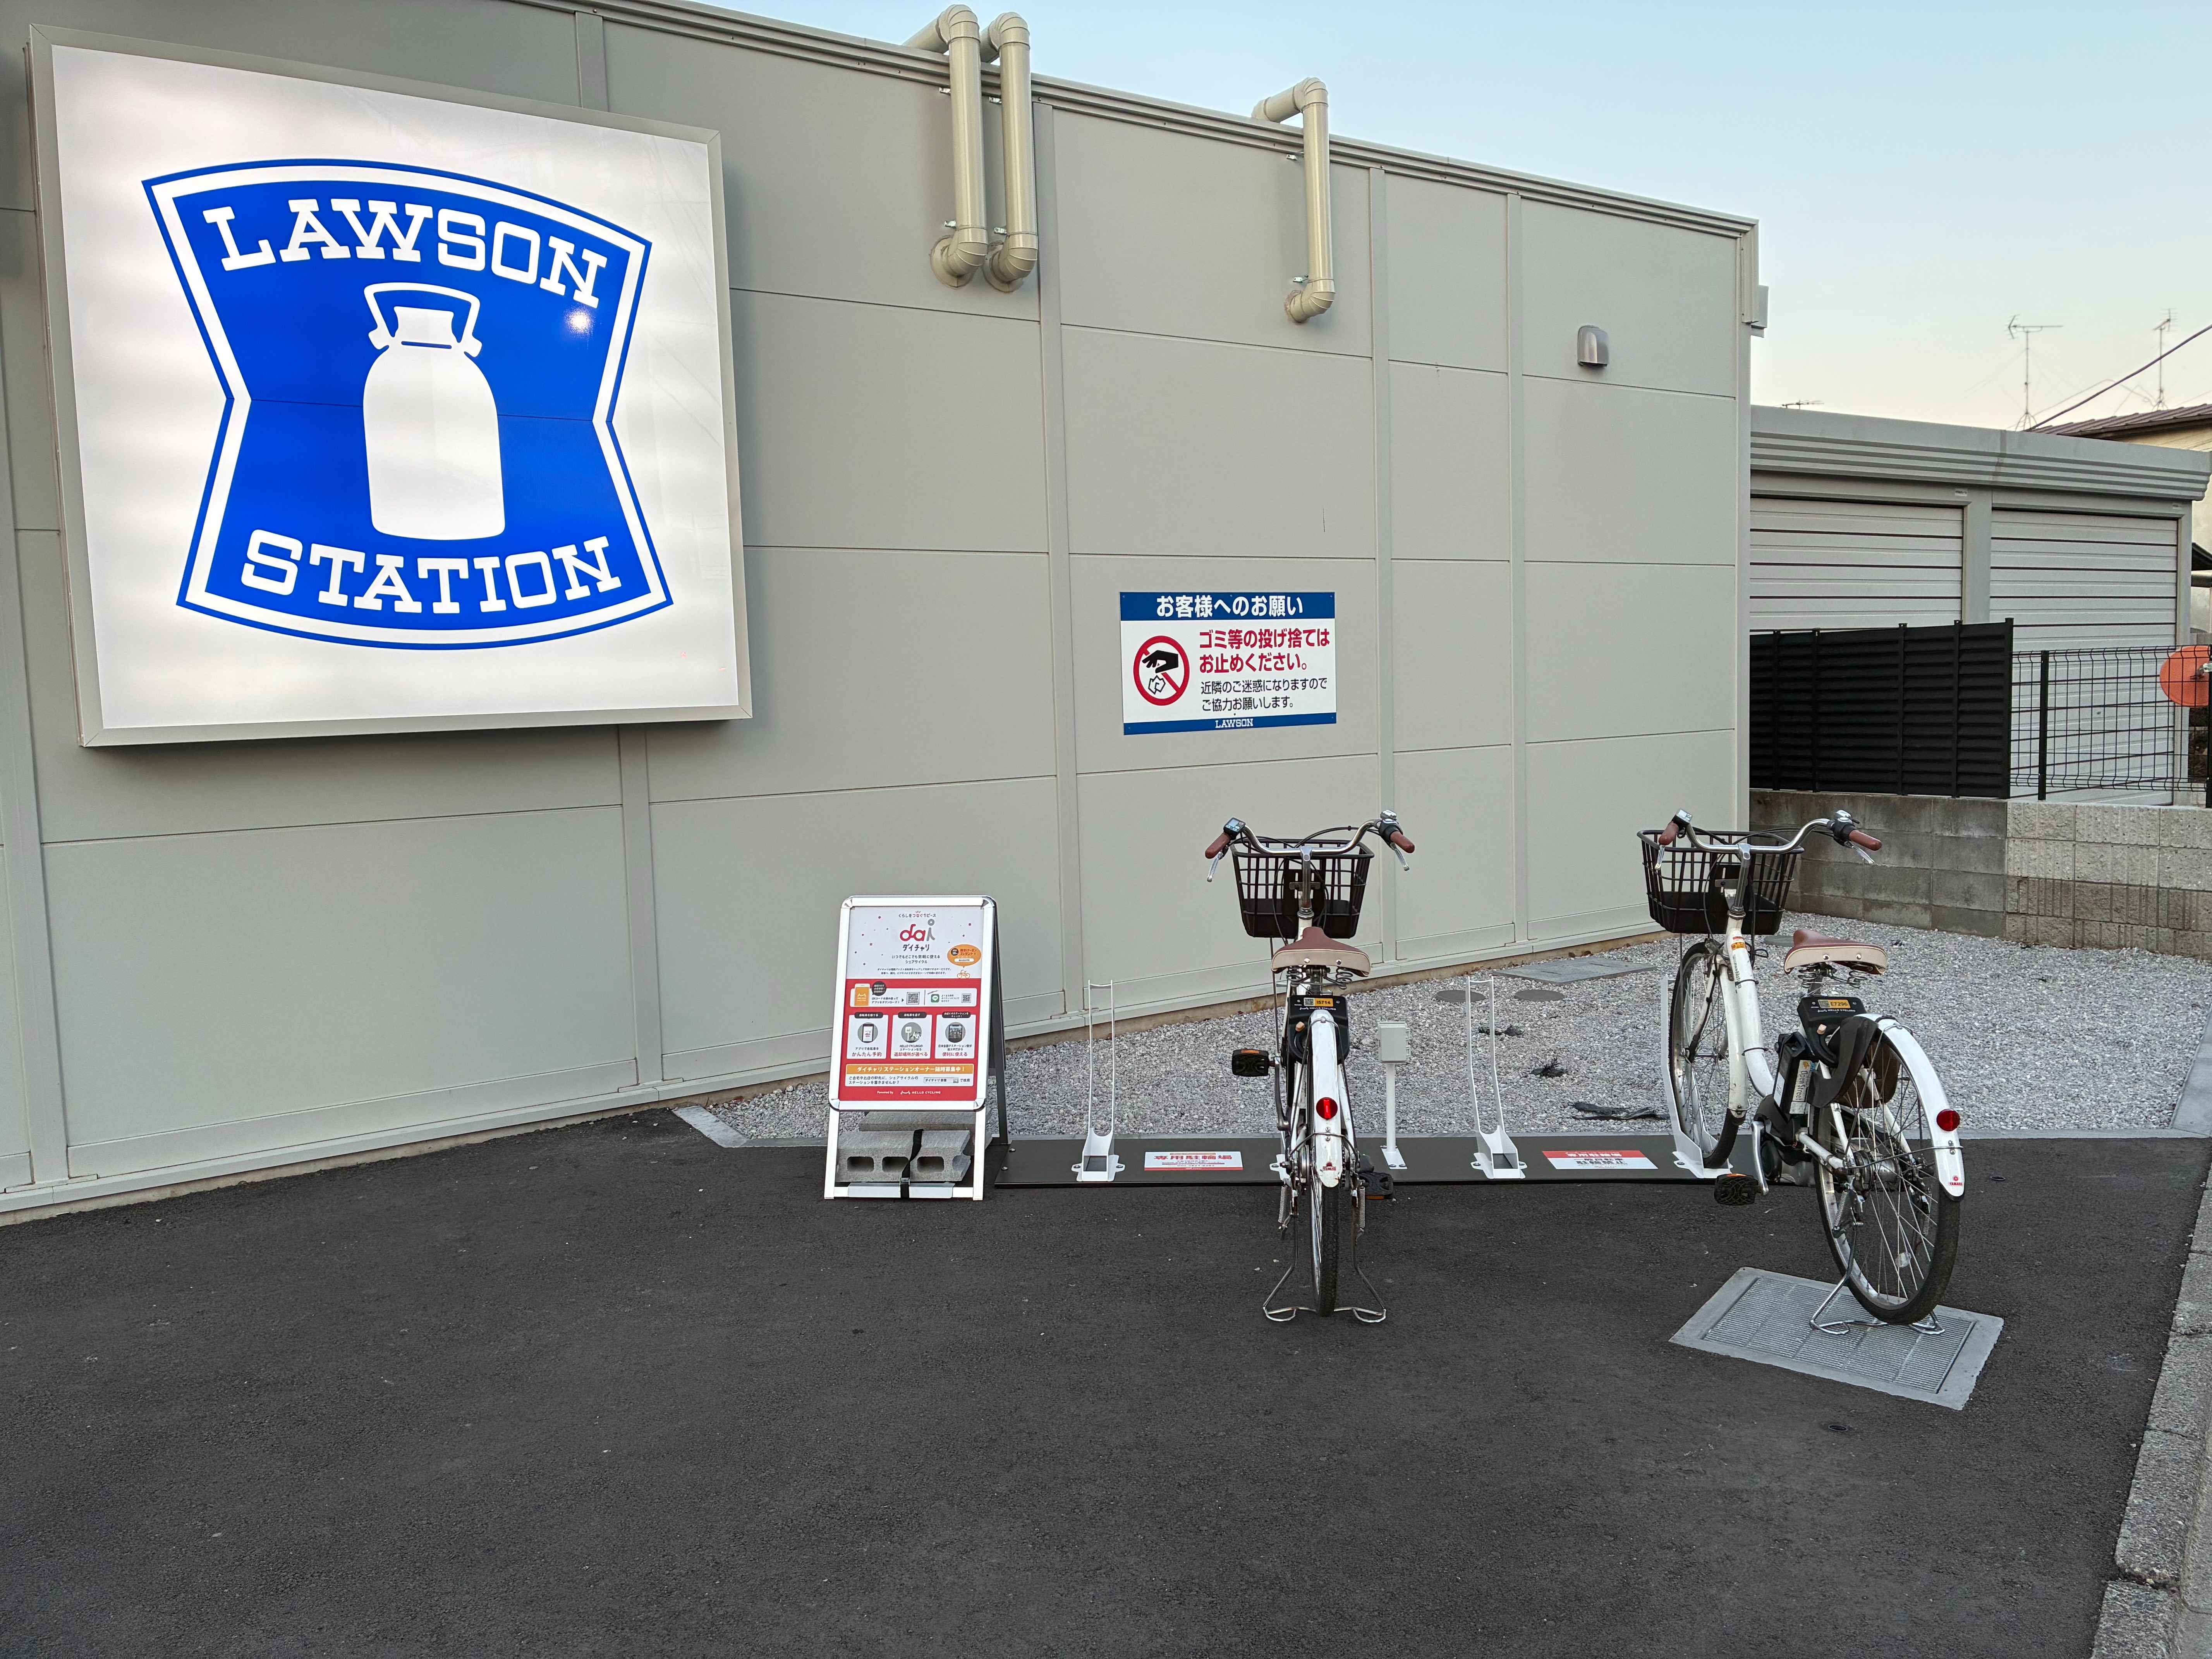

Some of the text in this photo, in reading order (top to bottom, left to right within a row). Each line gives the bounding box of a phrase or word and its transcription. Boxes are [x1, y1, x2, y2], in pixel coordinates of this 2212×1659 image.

[203, 198, 607, 308] LAWSON
[241, 529, 622, 614] STATION
[1156, 595, 1303, 617] お客様へのお願い
[1199, 628, 1330, 649] ゴミ等の投げ捨ては
[1199, 653, 1307, 674] お止めください。
[1201, 677, 1328, 695] 近隣のご迷惑になりますので
[1202, 695, 1294, 712] ご協力お願いします。
[1215, 718, 1254, 728] LAWSON
[900, 919, 935, 941] dai
